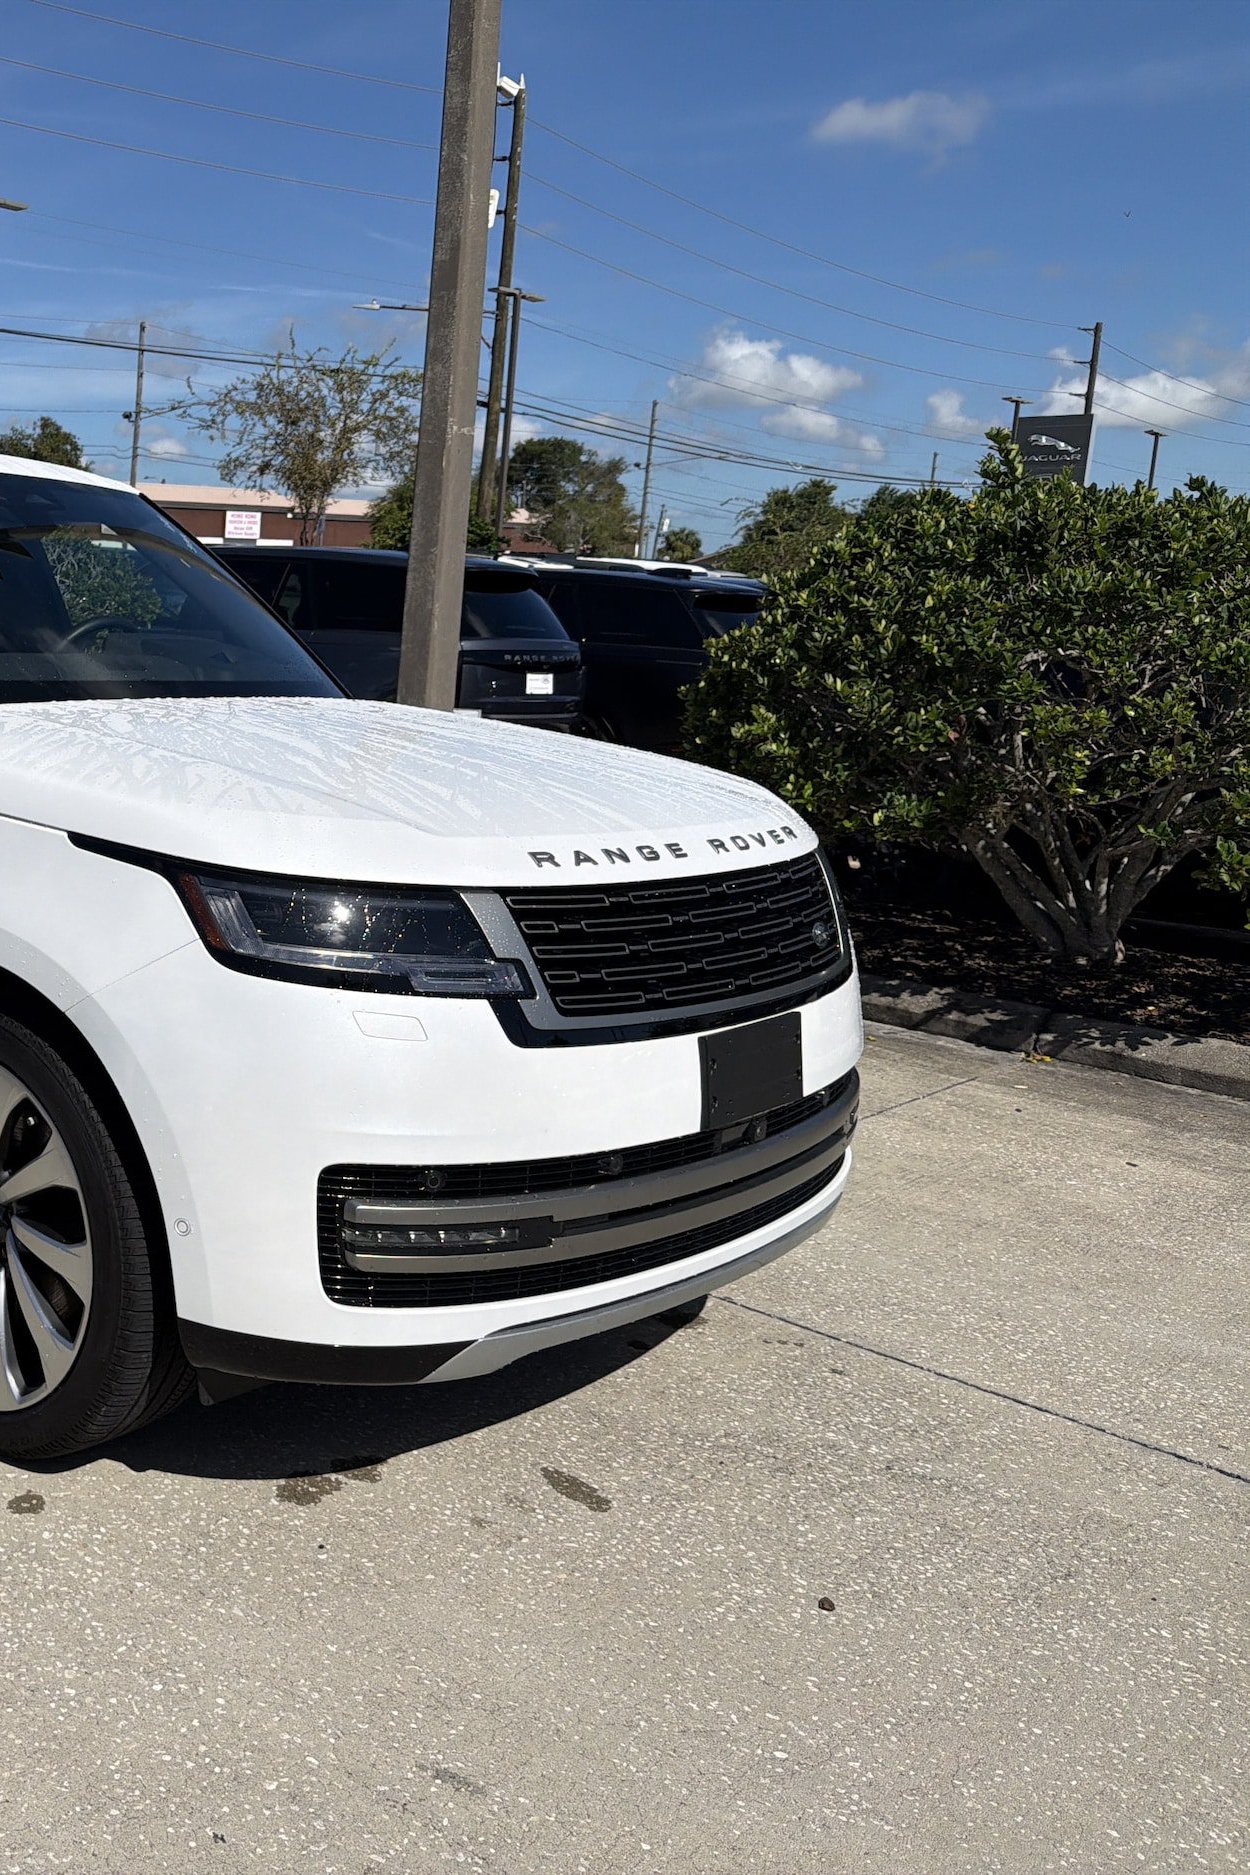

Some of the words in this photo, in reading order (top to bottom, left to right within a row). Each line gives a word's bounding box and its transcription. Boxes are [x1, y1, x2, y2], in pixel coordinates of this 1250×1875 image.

[1022, 453, 1081, 461] JAGUAR
[503, 654, 546, 662] RANGE
[527, 842, 688, 868] RANGE
[706, 825, 798, 855] ROVER
